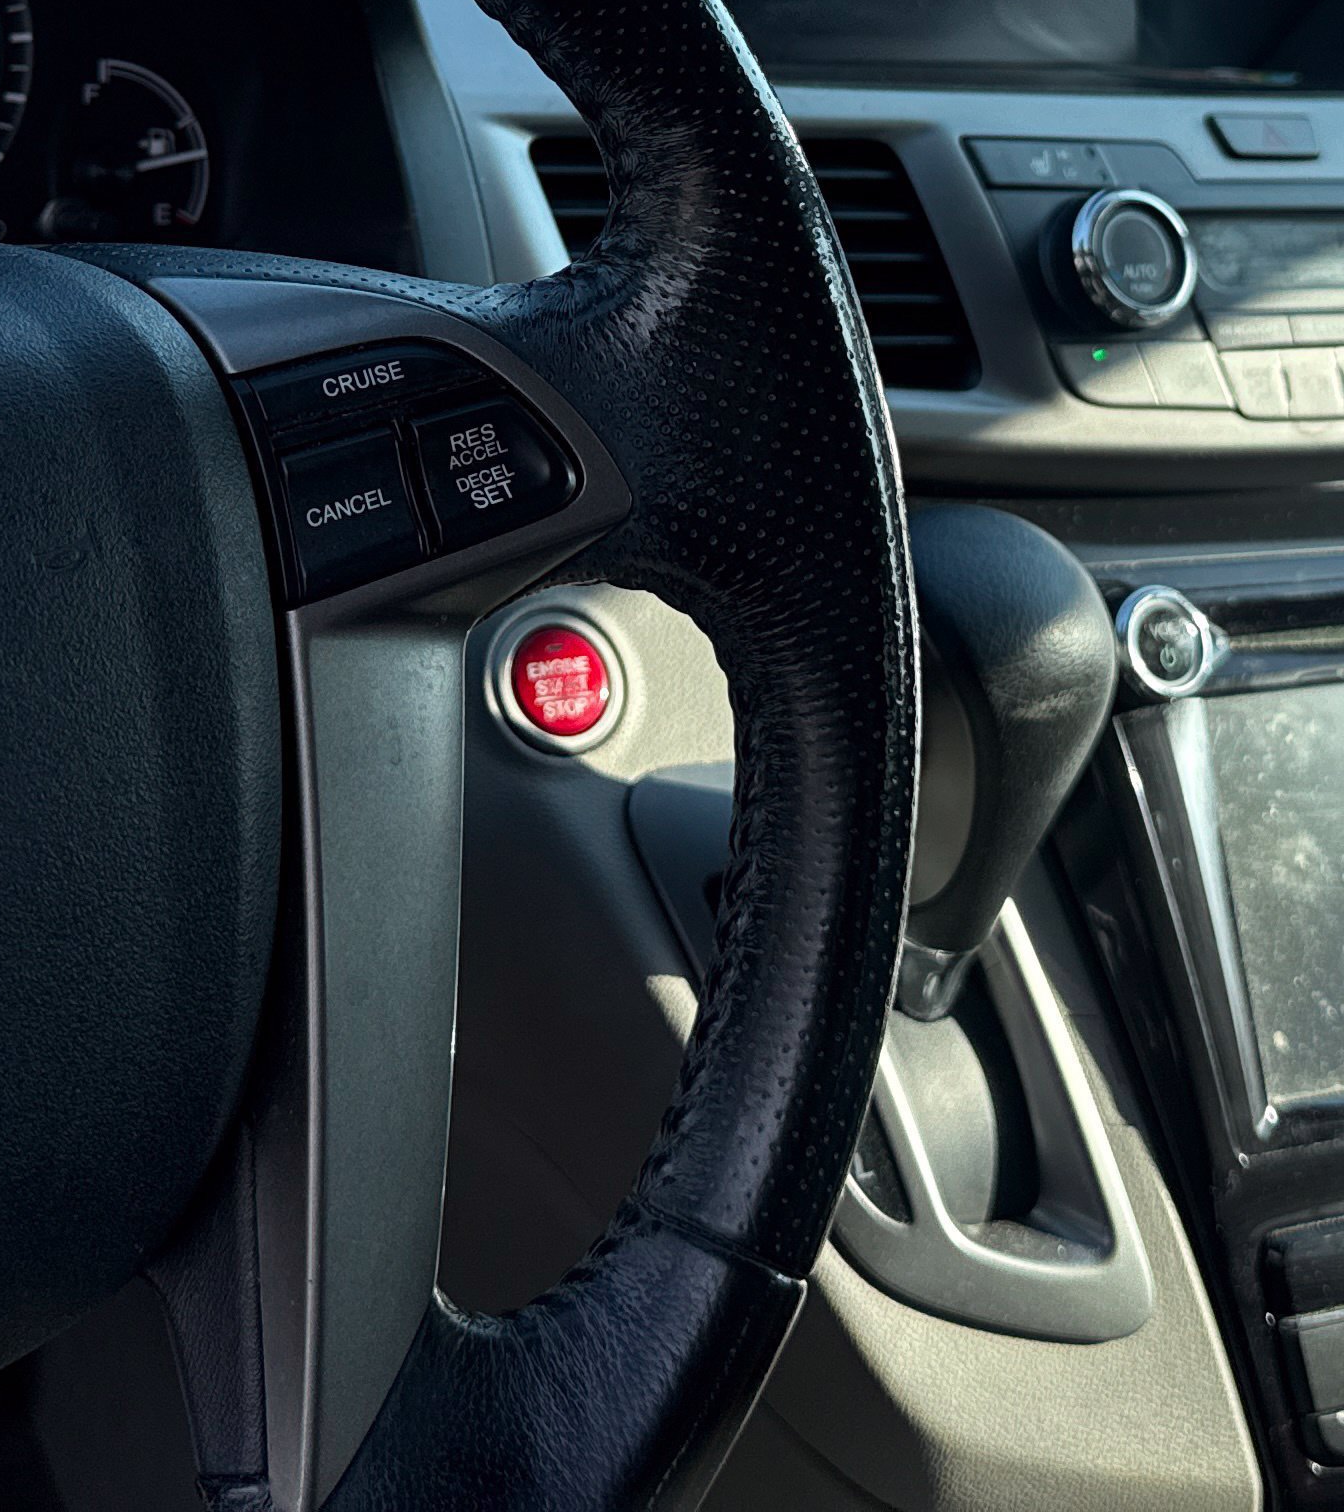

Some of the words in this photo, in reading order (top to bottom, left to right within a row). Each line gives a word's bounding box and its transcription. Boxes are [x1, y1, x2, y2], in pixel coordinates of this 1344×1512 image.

[81, 83, 102, 106] F
[153, 202, 173, 226] E
[1122, 263, 1157, 280] AUTO
[322, 361, 405, 398] CRUISE
[449, 423, 496, 454] RES
[448, 441, 509, 471] ACCEL
[455, 463, 516, 493] DECEL
[306, 488, 392, 528] CANCEL
[470, 480, 515, 510] SET
[526, 655, 591, 691] ENGINE
[542, 696, 589, 722] STOP
